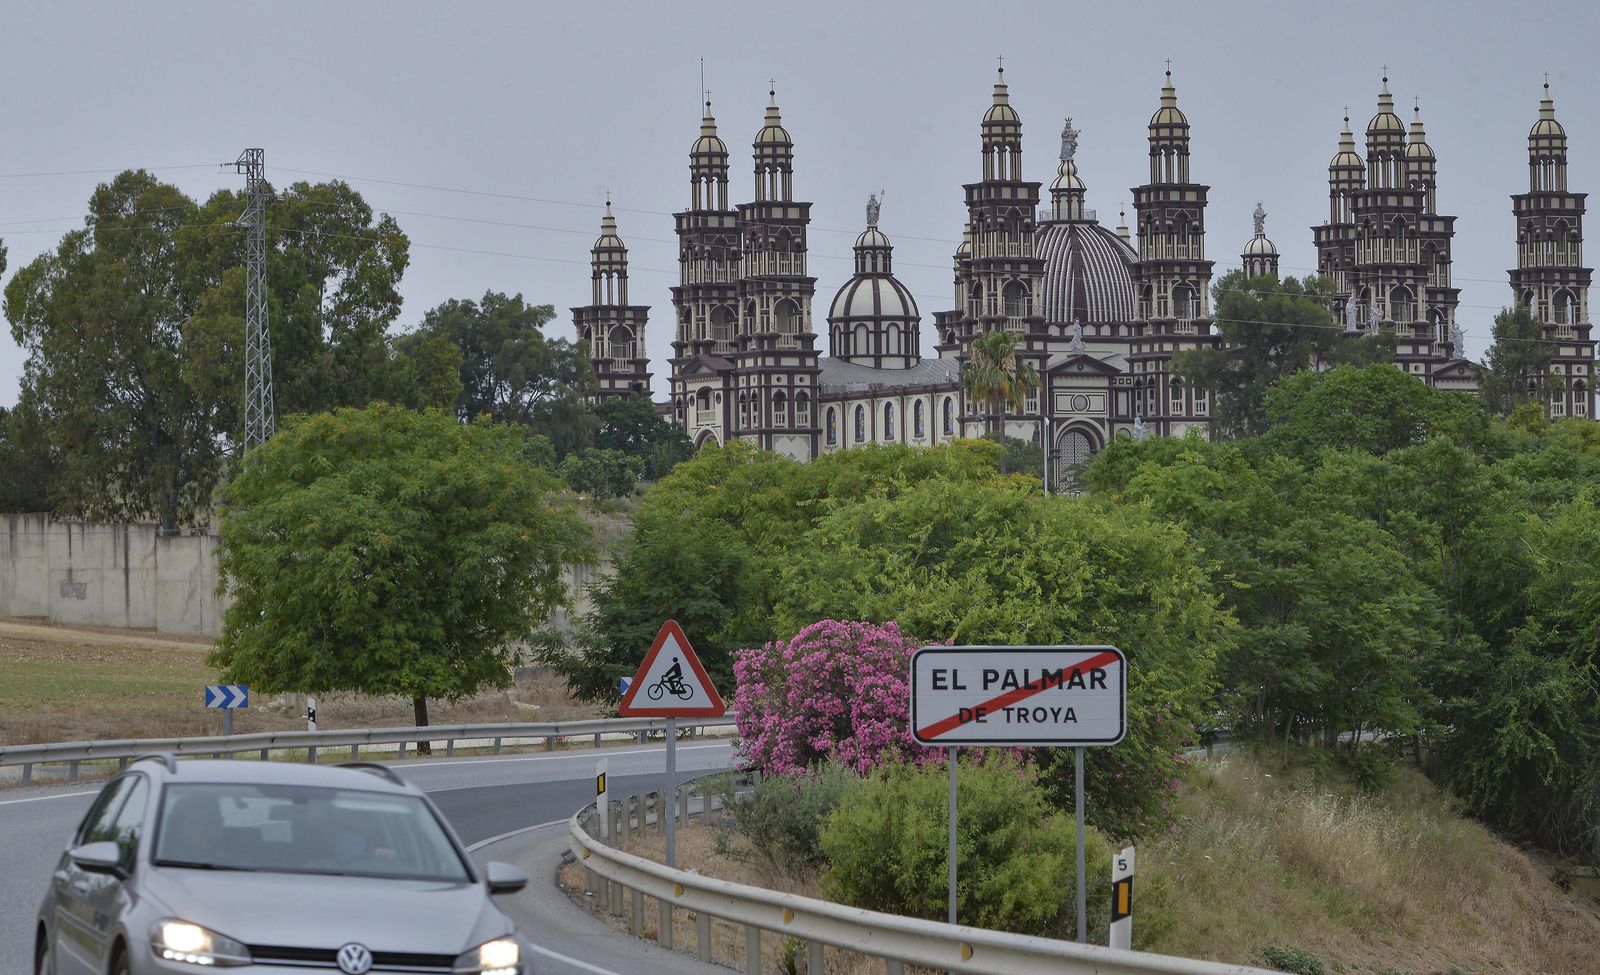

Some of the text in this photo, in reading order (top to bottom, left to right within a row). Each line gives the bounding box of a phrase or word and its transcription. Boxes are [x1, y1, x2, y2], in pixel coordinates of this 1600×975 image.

[932, 668, 1107, 690] EL PALMAR
[959, 707, 1078, 723] DE TROYA
[1118, 859, 1127, 871] 5
